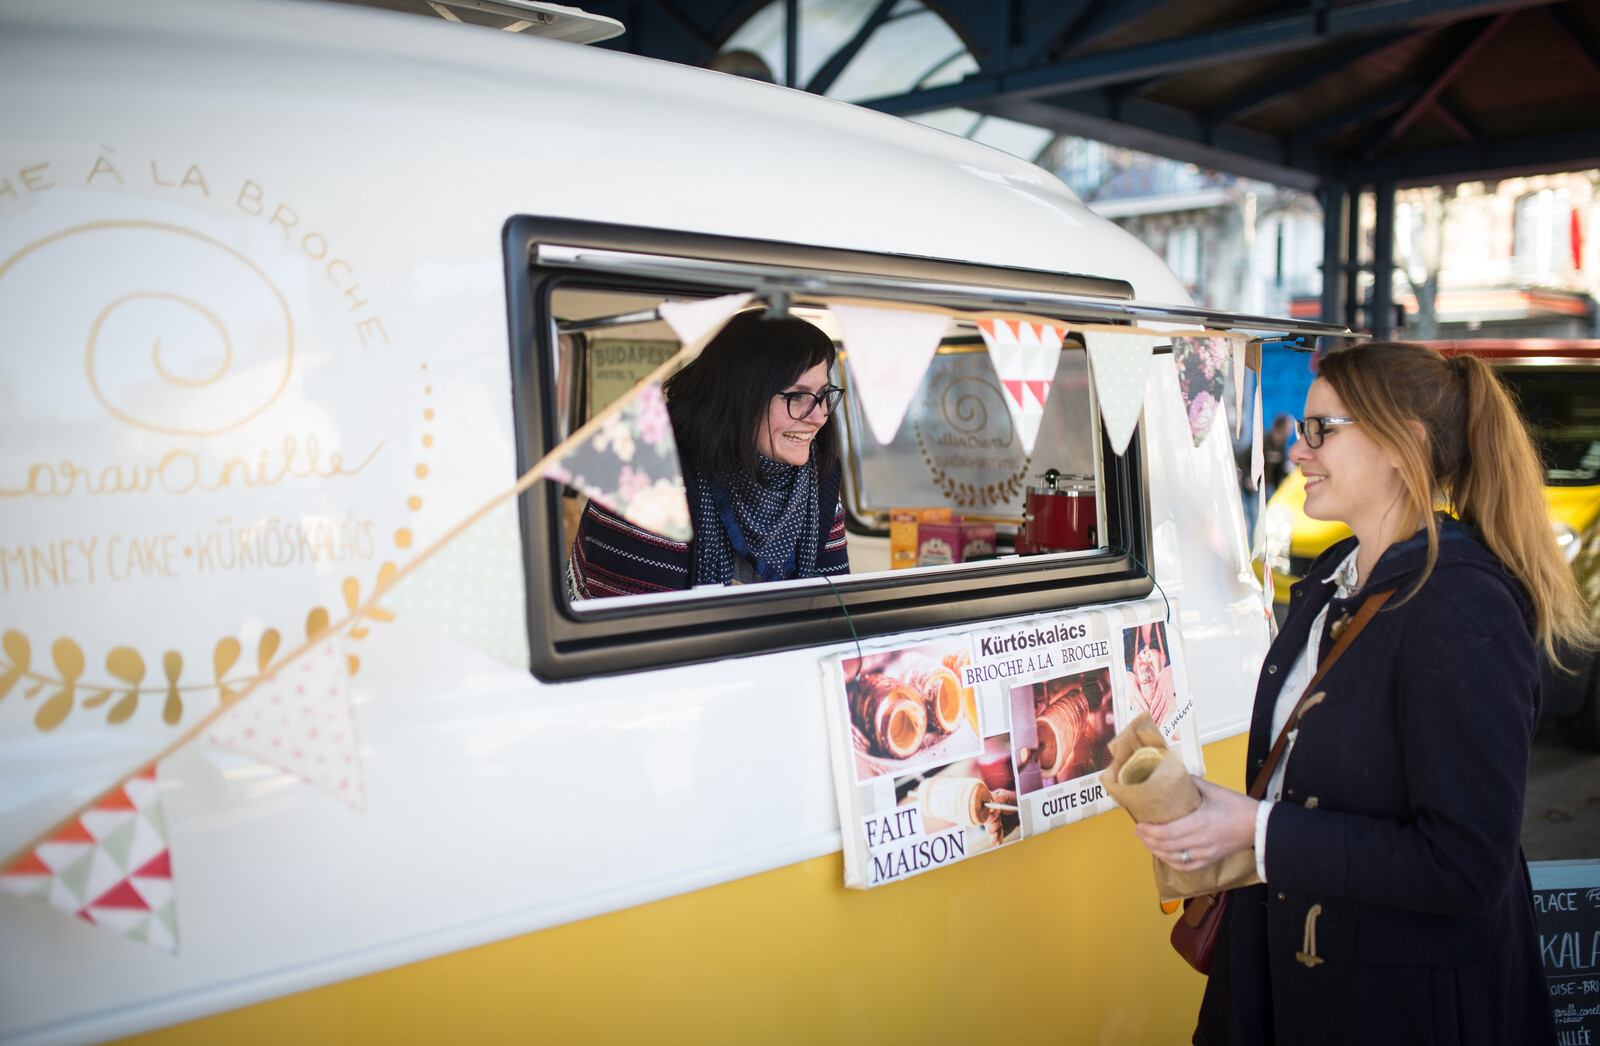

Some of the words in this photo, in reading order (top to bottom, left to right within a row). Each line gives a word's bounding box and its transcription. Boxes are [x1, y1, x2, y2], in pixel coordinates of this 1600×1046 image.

[150, 160, 210, 198] LA
[236, 178, 391, 348] BROCHE
[0, 535, 99, 594] MNEY
[106, 532, 180, 583] CAKE
[966, 658, 1024, 685] BRIOCHE
[1026, 656, 1036, 673] A
[1037, 652, 1055, 670] LA
[1061, 640, 1109, 664] BROCHE
[1041, 792, 1078, 817] CUITE
[1079, 784, 1104, 805] SUR
[864, 807, 918, 849] FAIT
[871, 830, 966, 884] MAISON
[1532, 891, 1579, 913] PLACE
